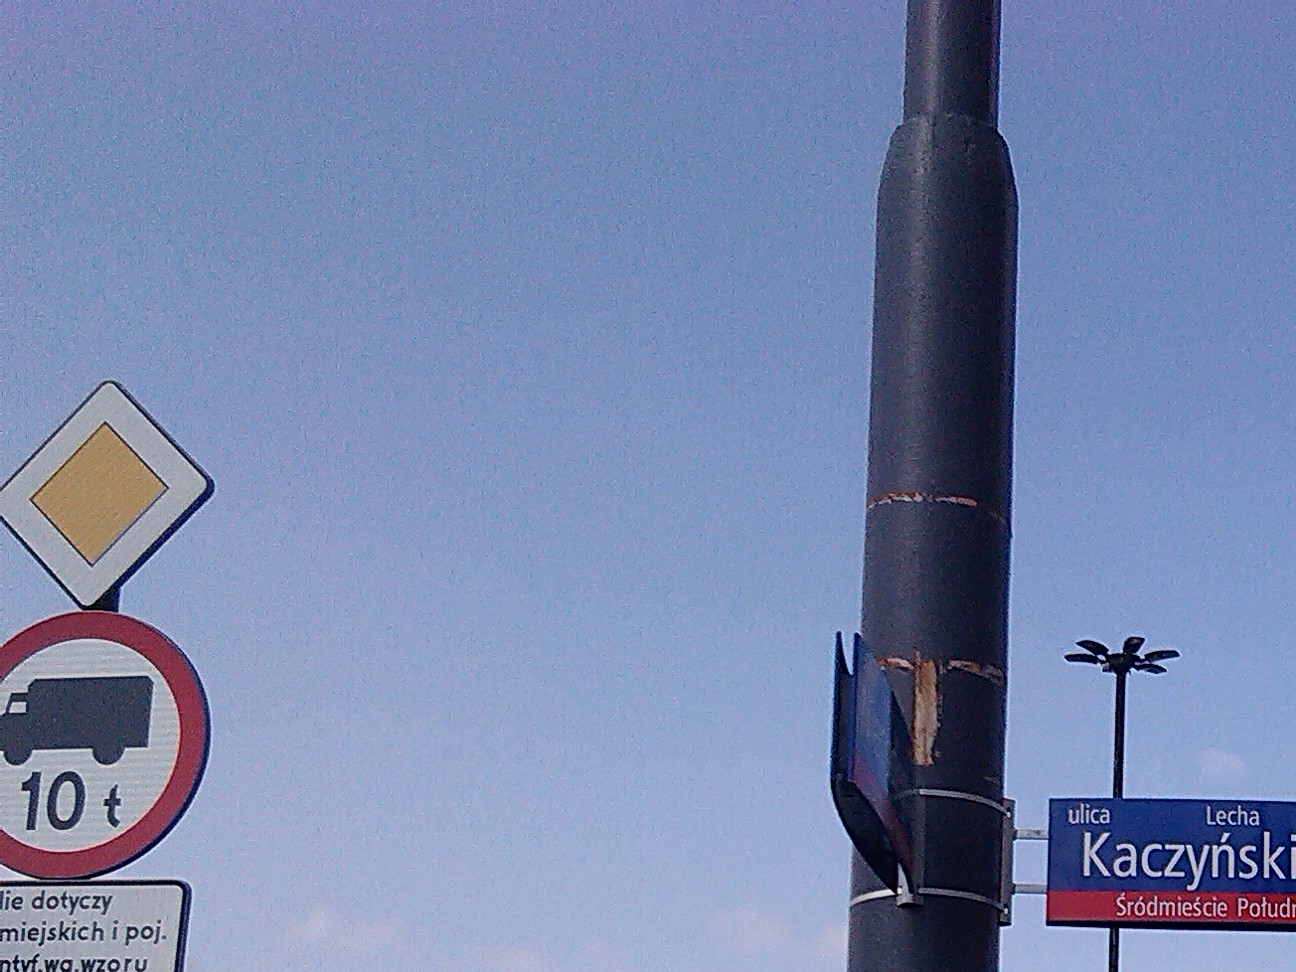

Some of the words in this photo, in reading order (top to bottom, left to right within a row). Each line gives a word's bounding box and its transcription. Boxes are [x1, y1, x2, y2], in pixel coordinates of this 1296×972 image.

[21, 771, 86, 831] 10
[103, 784, 122, 828] t
[1068, 803, 1111, 825] ulica
[1206, 805, 1260, 826] Lecha
[31, 890, 113, 916] dotyczy
[1115, 892, 1228, 918] Śródmieście
[0, 919, 104, 947] miejskich
[112, 919, 119, 941] i
[125, 919, 167, 946] poj.
